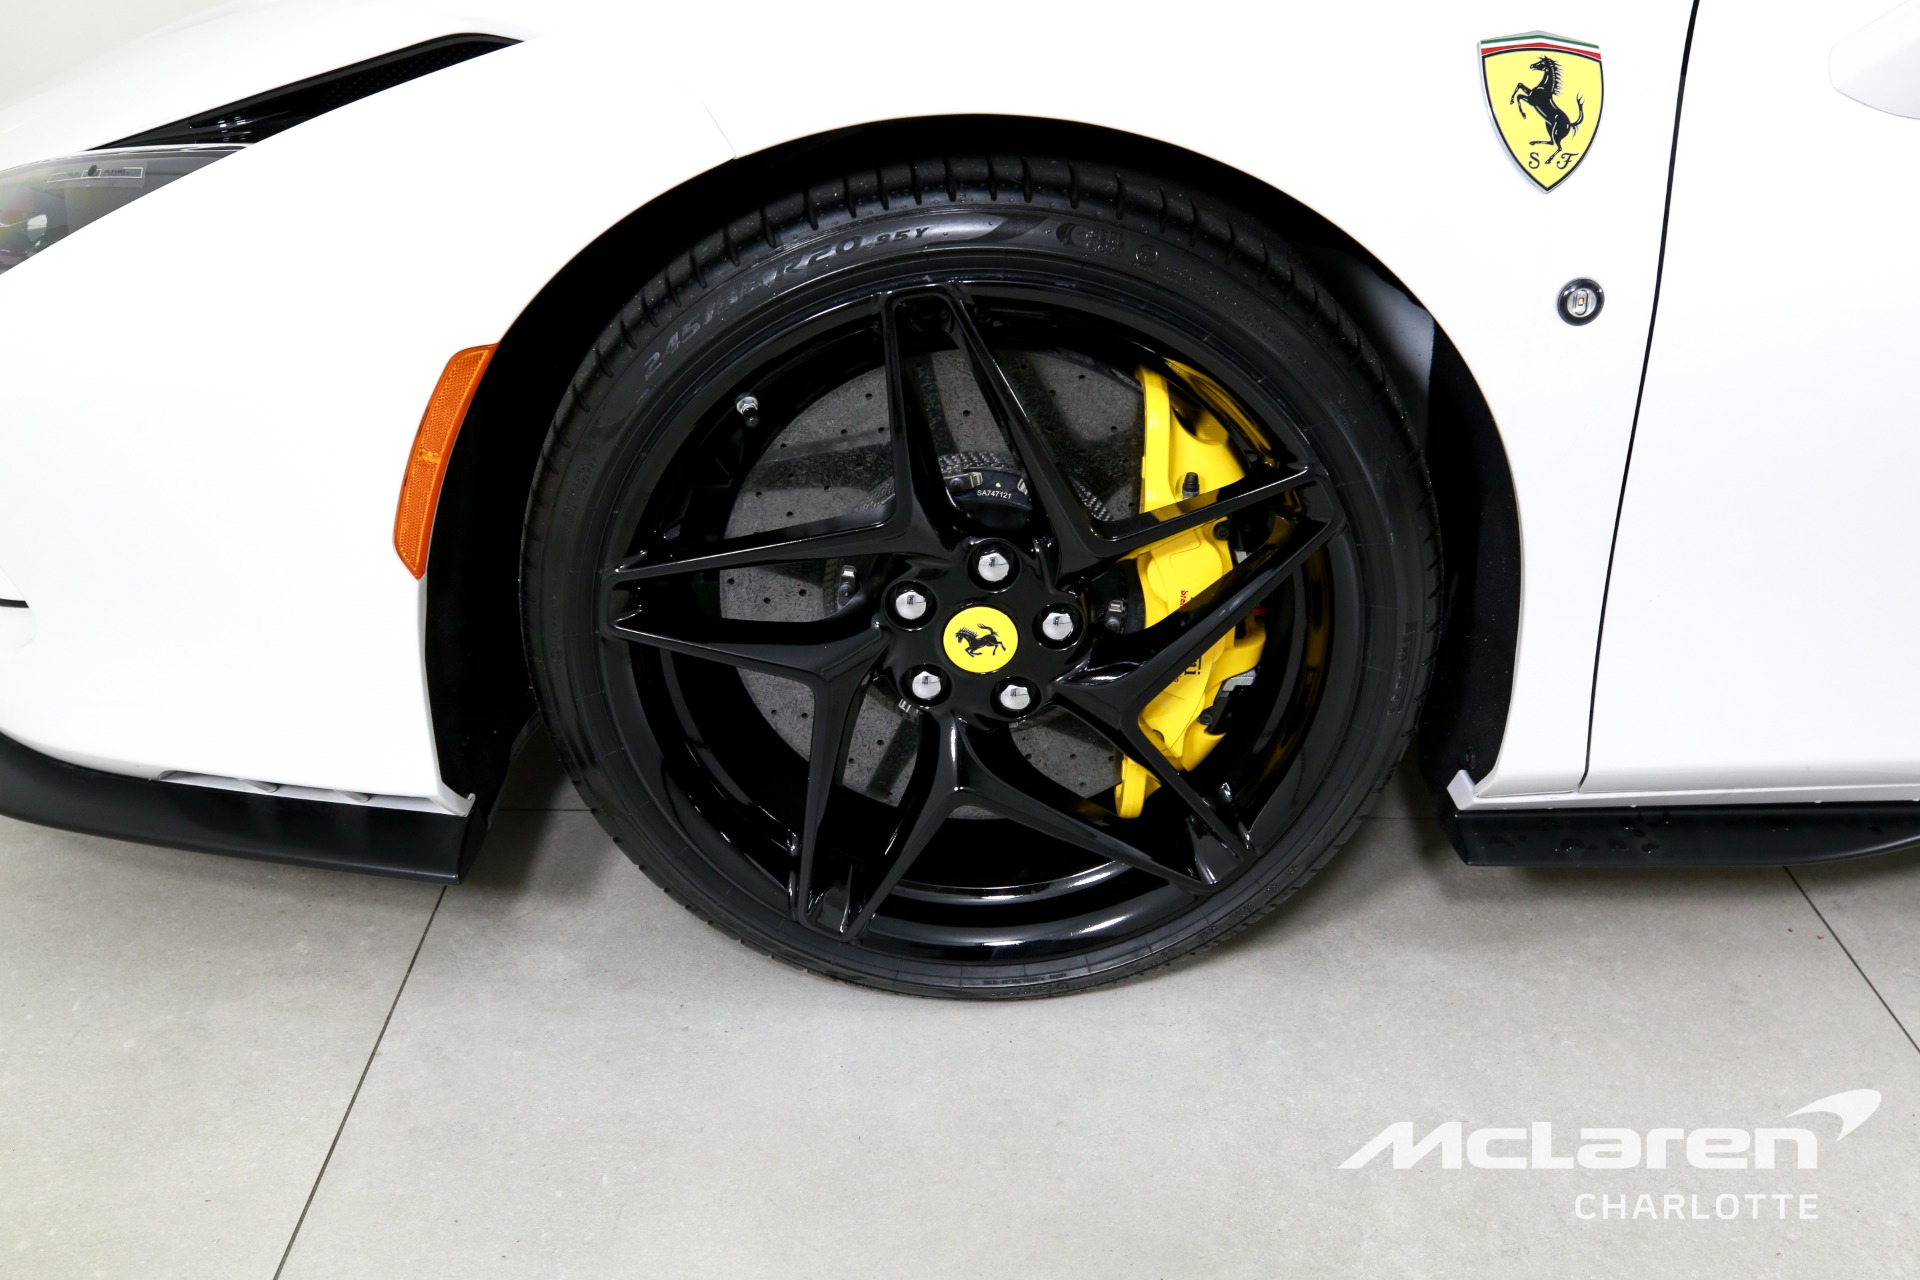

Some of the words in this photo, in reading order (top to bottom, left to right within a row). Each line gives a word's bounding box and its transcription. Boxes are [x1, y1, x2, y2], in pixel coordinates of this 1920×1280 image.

[1528, 151, 1540, 169] S
[1556, 152, 1580, 170] F
[976, 489, 1012, 500] SA747121
